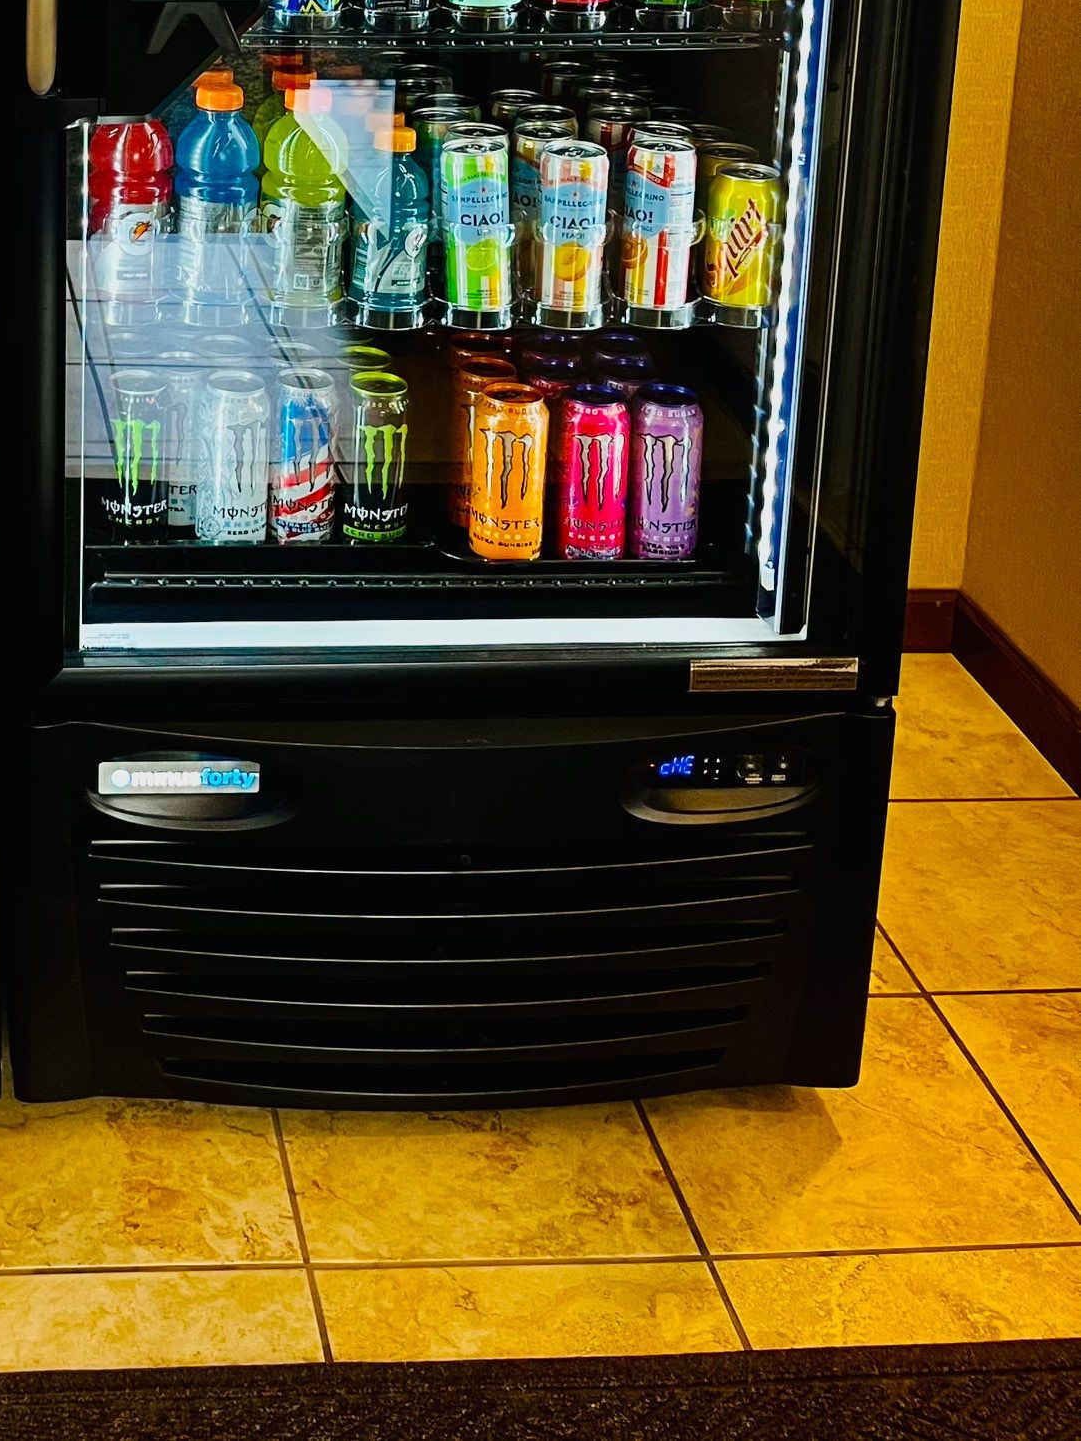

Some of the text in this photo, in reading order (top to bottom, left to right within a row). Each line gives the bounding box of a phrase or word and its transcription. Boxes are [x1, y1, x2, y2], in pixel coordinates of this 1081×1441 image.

[460, 212, 505, 227] CIAO!
[549, 214, 597, 230] CIAO!
[625, 206, 654, 224] IAO!
[272, 494, 333, 514] MONSTE
[344, 502, 409, 521] MONSTE
[470, 506, 541, 531] MONSTER
